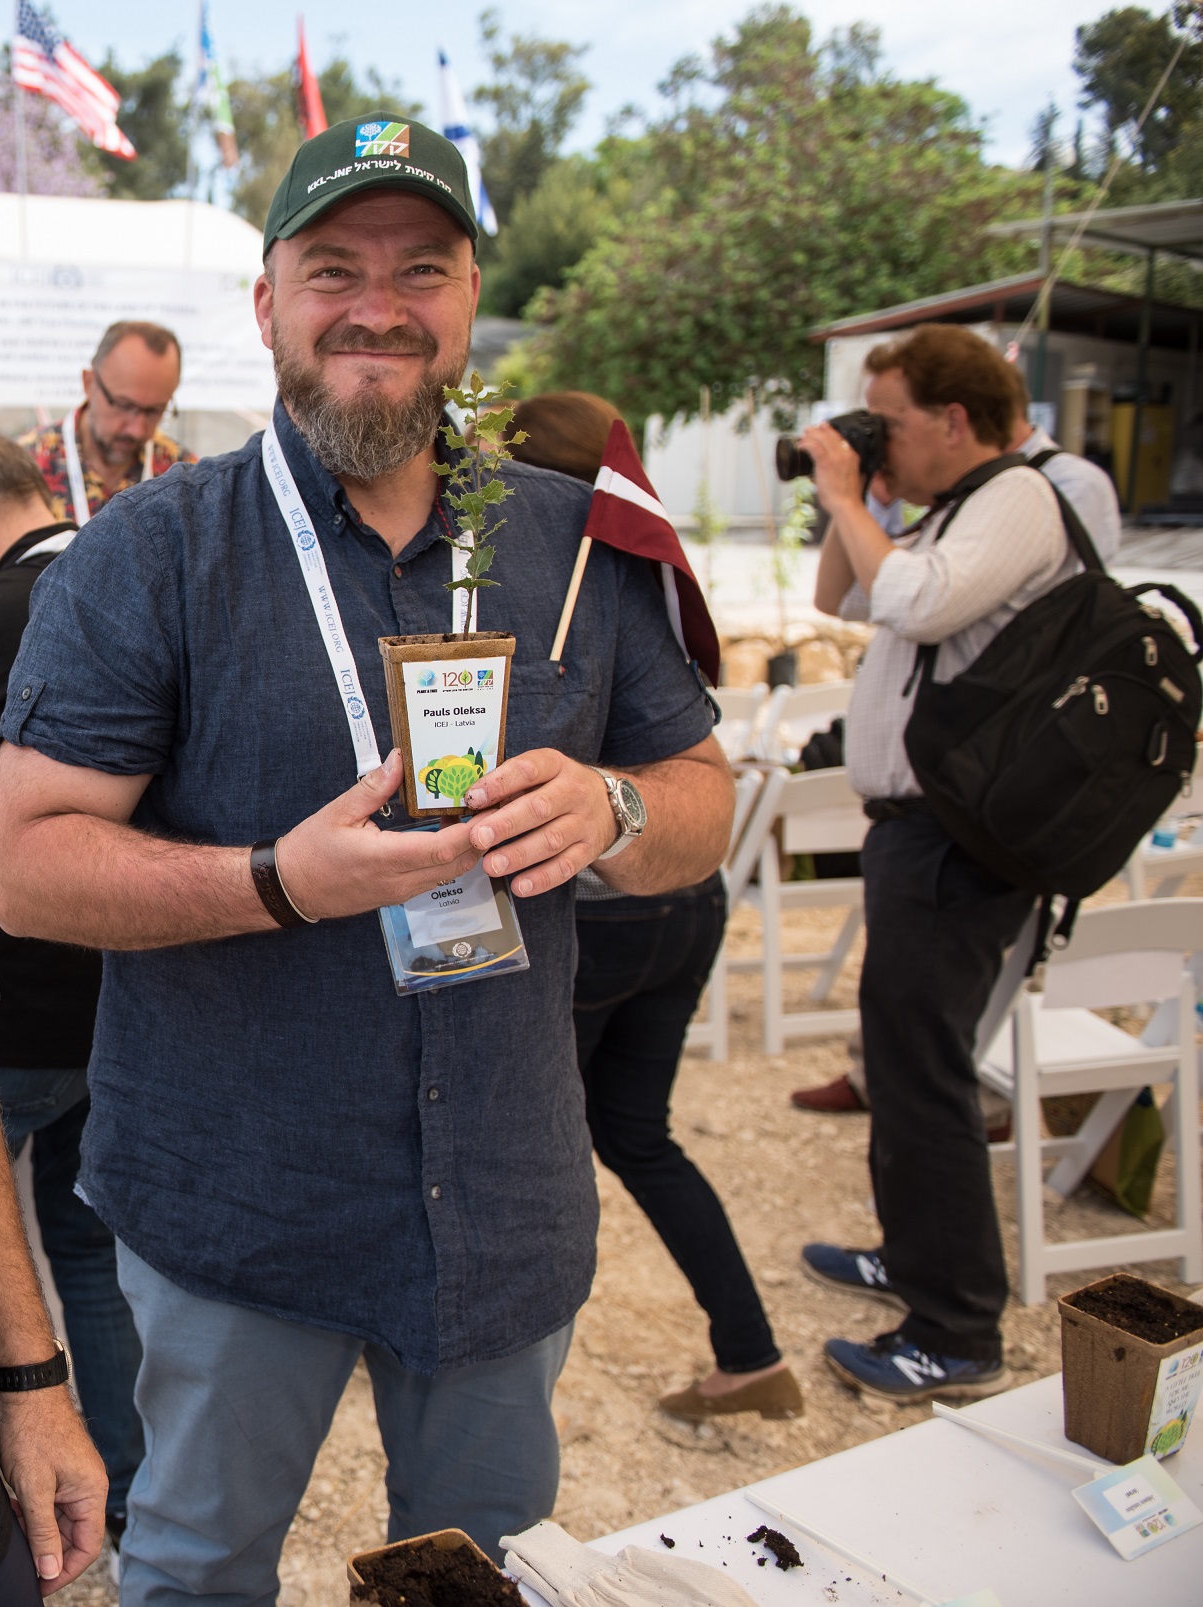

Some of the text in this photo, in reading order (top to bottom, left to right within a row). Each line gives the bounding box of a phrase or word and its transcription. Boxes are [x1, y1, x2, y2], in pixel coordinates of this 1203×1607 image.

[354, 159, 402, 173] לישראל
[307, 165, 353, 194] KKL-JNF
[289, 507, 307, 531] ICEJ
[318, 585, 344, 653] WWW.ICEJ.ORG
[340, 669, 356, 696] ICEJ
[423, 706, 486, 717] Pauls Oleksa
[431, 888, 463, 900] Oleksa
[439, 898, 460, 908] Latvia
